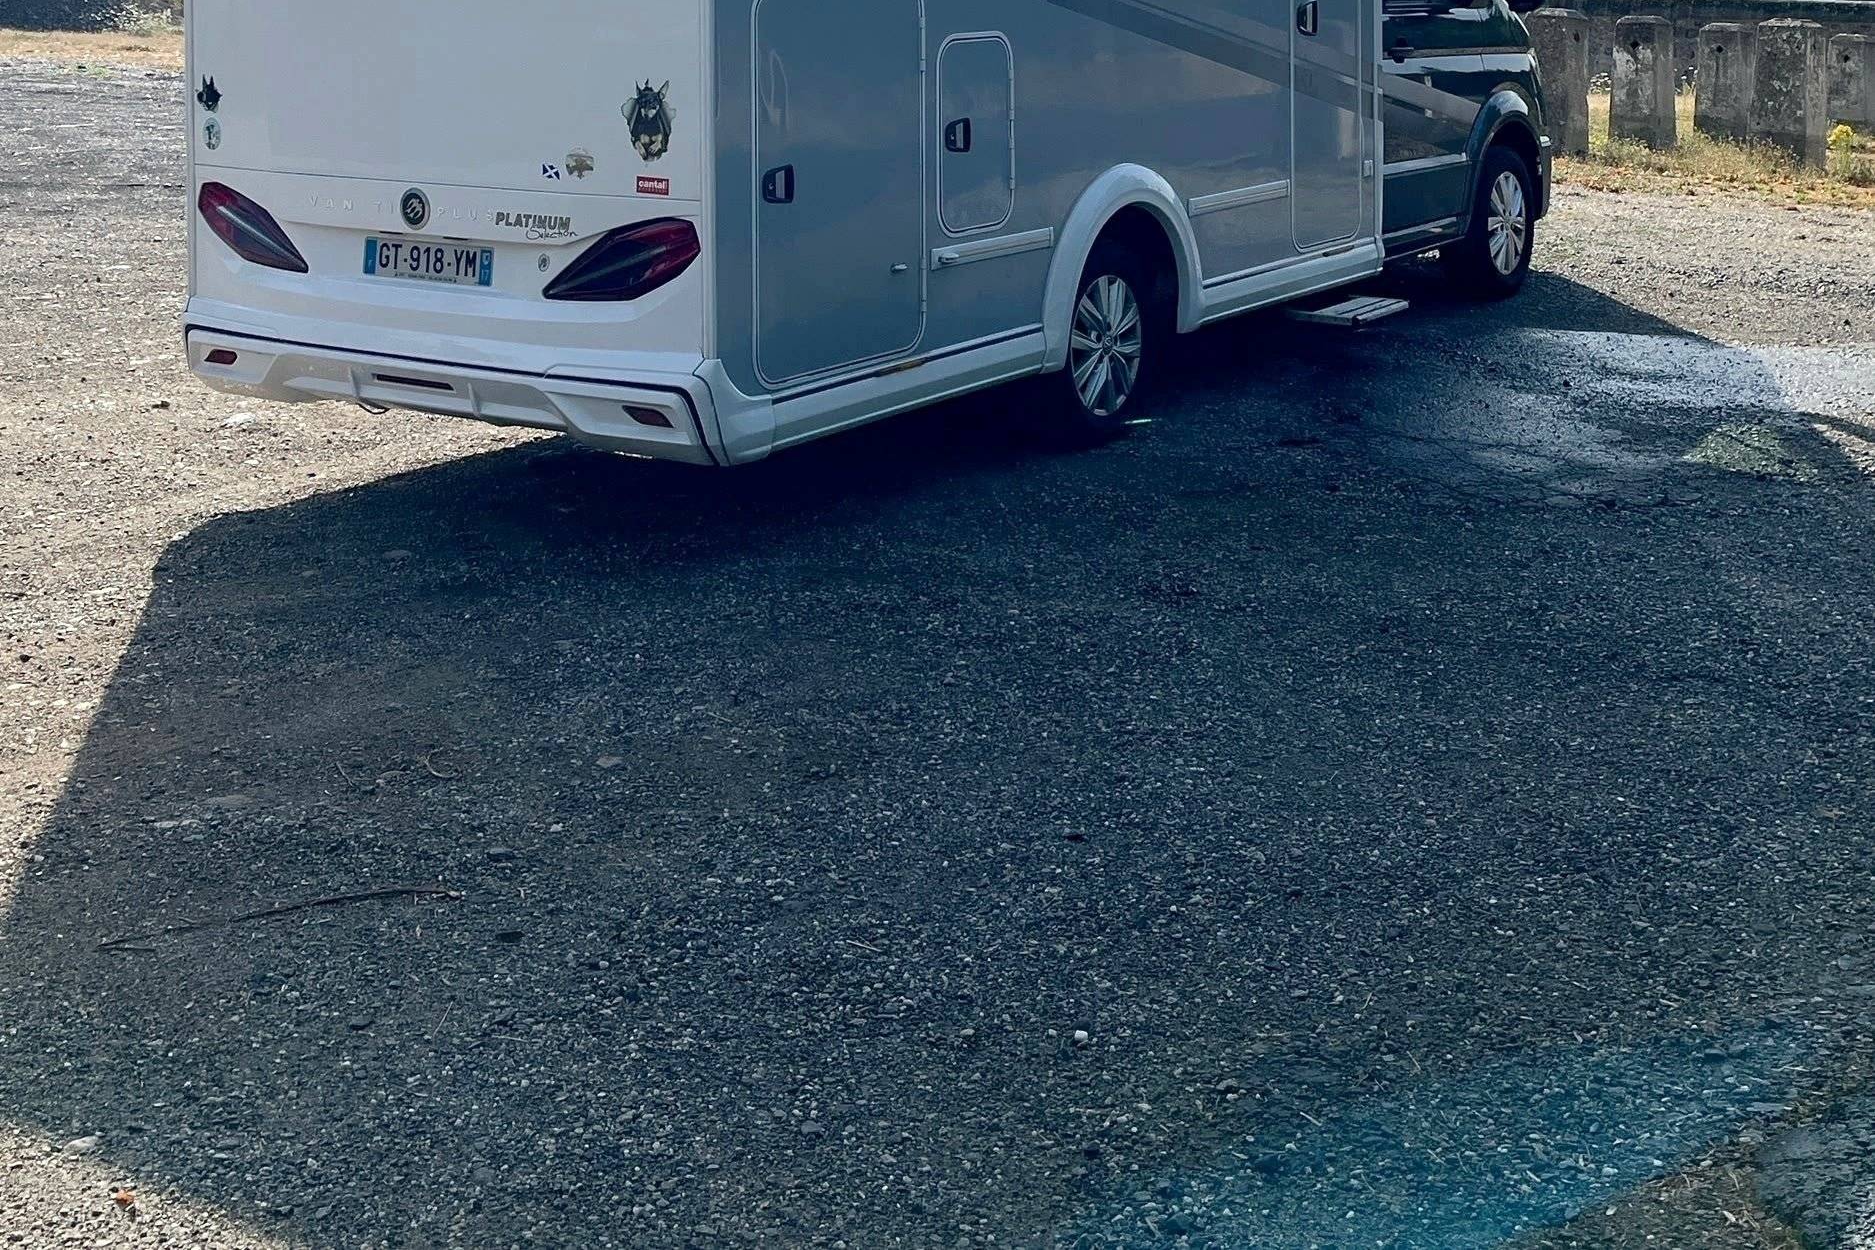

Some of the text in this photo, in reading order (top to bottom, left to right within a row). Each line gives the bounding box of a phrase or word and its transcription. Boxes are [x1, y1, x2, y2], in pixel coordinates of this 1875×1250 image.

[638, 180, 666, 190] cantal
[309, 195, 354, 212] VAN
[437, 207, 494, 222] PLUS
[495, 211, 571, 232] PLATINUM
[526, 225, 579, 241] Selection
[379, 242, 478, 278] GT-918-YM
